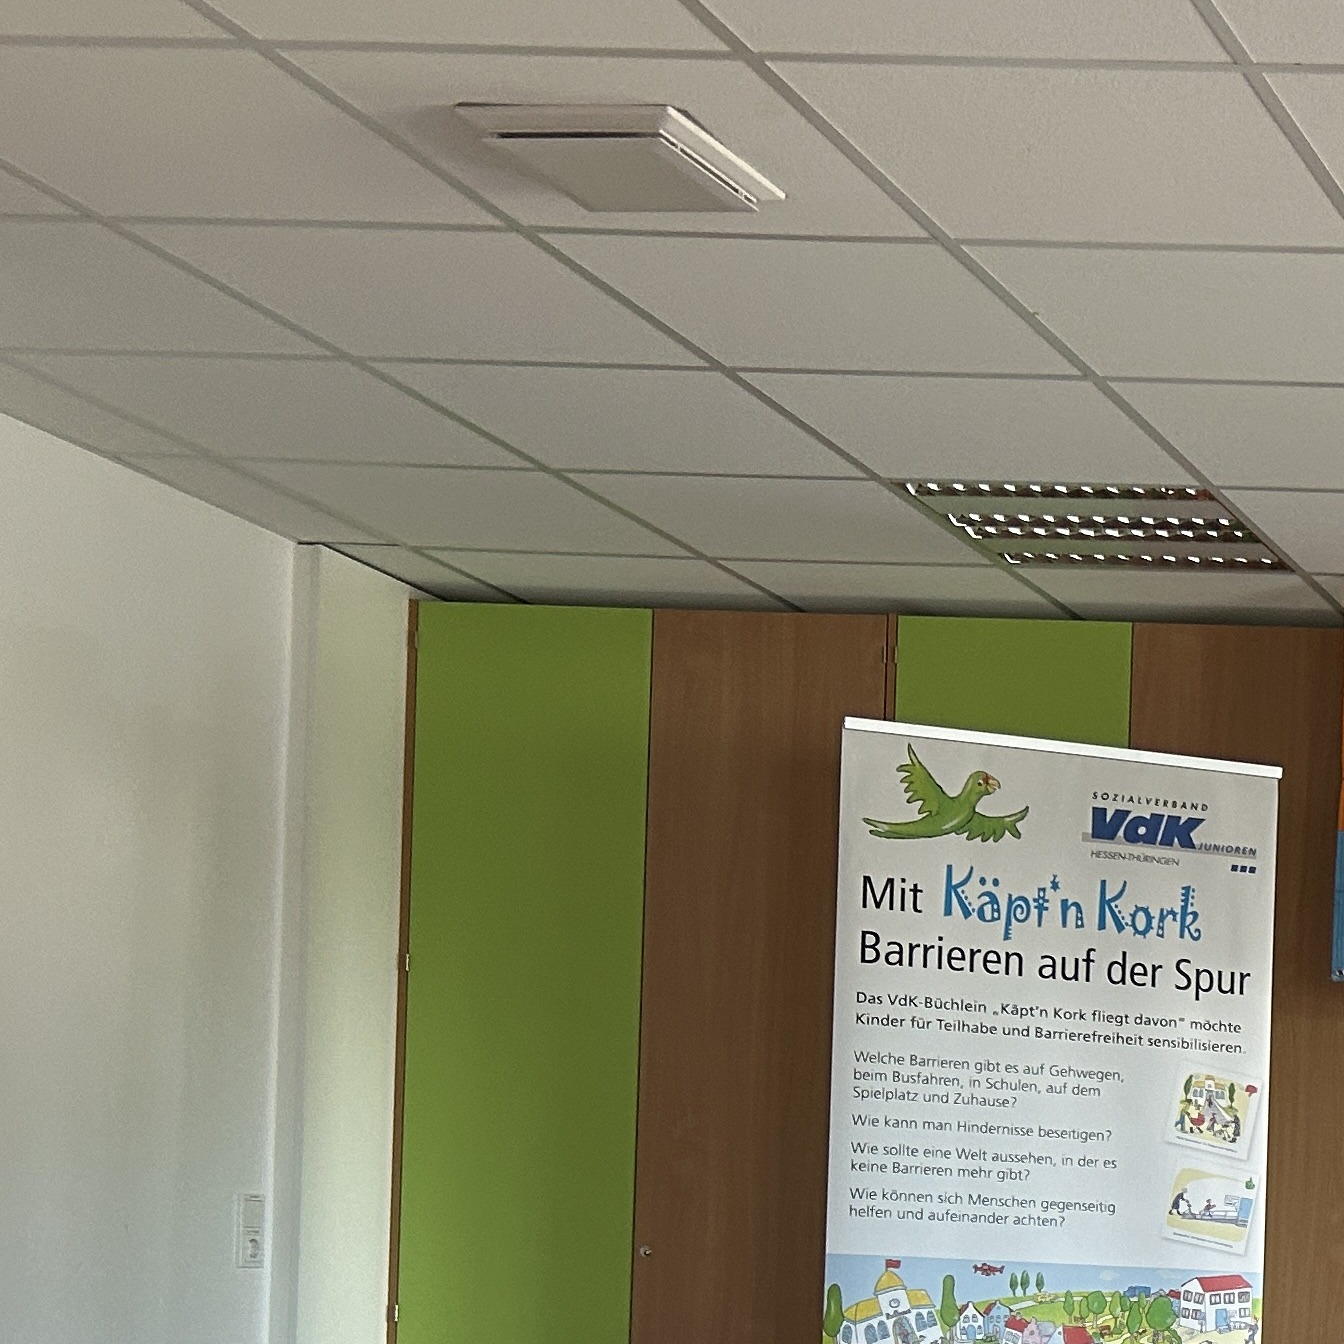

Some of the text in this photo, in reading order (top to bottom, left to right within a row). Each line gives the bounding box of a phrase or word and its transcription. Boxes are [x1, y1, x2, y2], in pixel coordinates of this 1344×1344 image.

[1092, 791, 1209, 812] SOZIALVERBAND
[1091, 806, 1257, 856] VdK JUNIOREN
[860, 874, 924, 914] Mit
[1097, 879, 1202, 942] Kork
[859, 929, 1252, 1001] Barrieren auf der Spur
[856, 991, 883, 1005] Das
[887, 993, 987, 1014] VdK-Büchlein
[1053, 1007, 1087, 1022] Kork
[1091, 1009, 1130, 1027] fliegt
[1189, 1019, 1242, 1034] möchte
[855, 1012, 1247, 1055] Kinder für Teilhabe und Barrierefreiheit sensibilisieren.
[854, 1050, 1125, 1084] Welche Barrieren gibt es auf Gehwegen,
[853, 1068, 1101, 1097] beim Busfahren, in Schulen, auf dem
[853, 1085, 1018, 1109] Spielplatz und Zuhause?
[851, 1113, 1112, 1143] Wie kann man Hindernisse beseitigen?
[850, 1141, 1118, 1170] Wie sollte eine Welt aussehen, in der es
[850, 1159, 1031, 1182] keine Barrieren mehr gibt?
[849, 1187, 1117, 1216] Wie können sich Menschen gegenseitig
[849, 1204, 1066, 1229] helfen und aufeinander achten?
